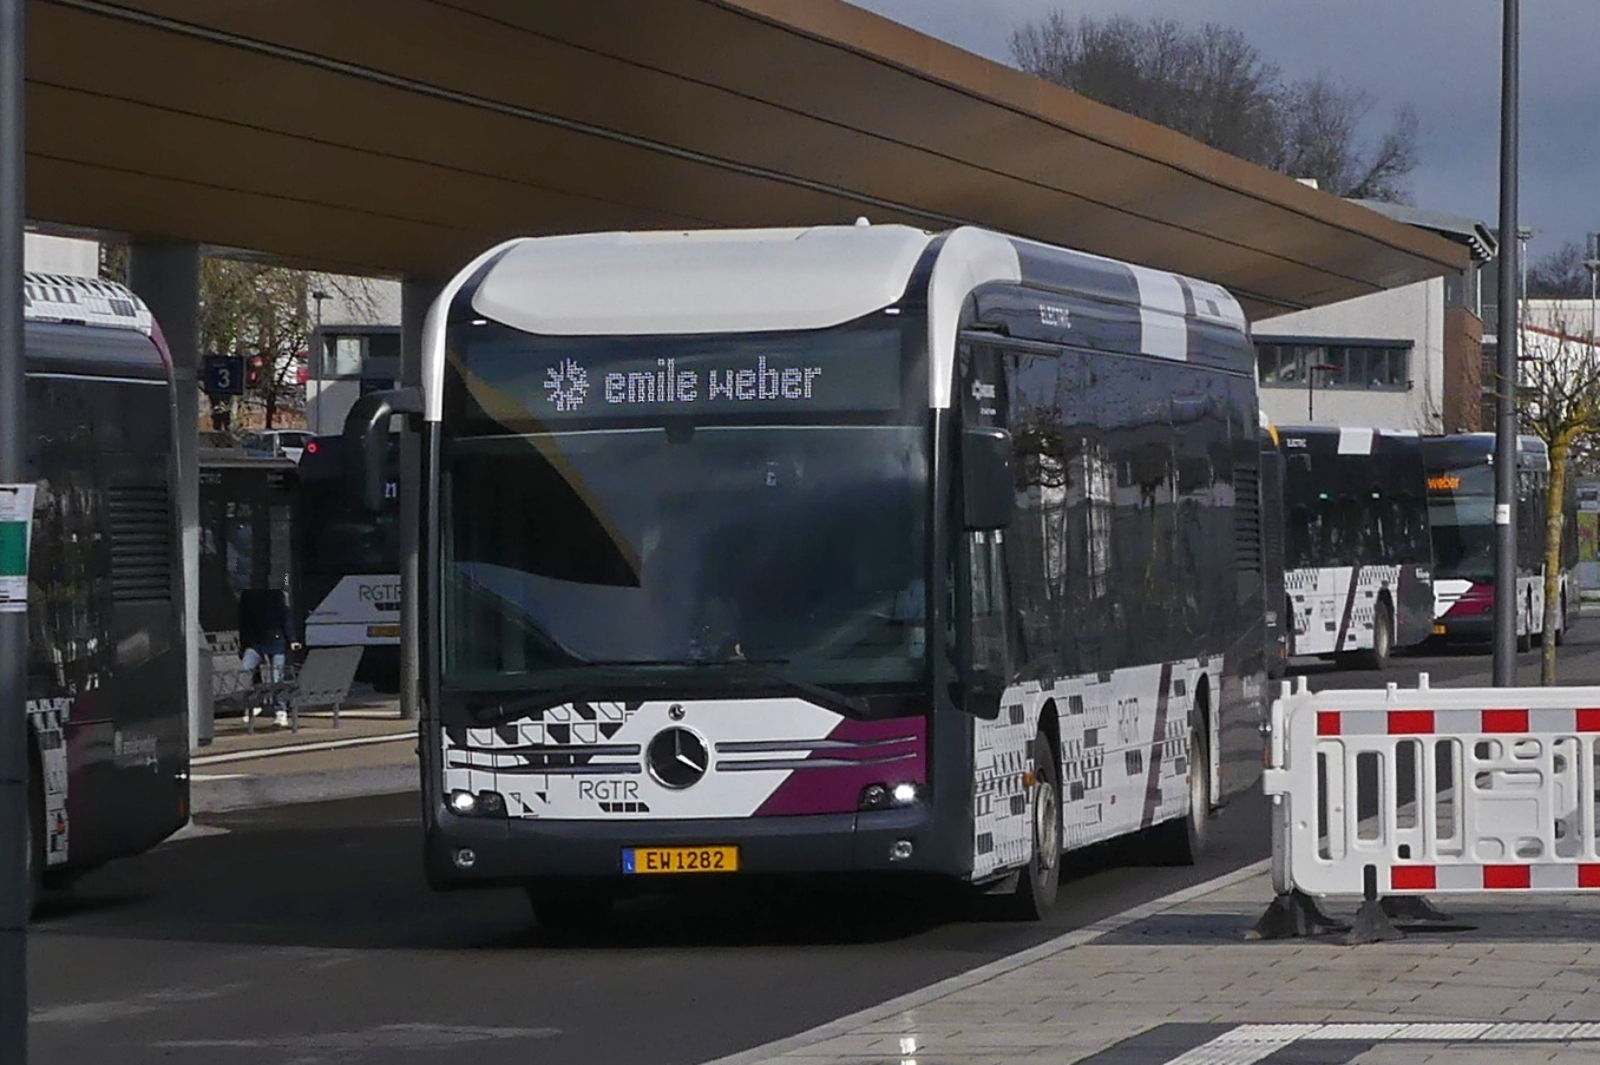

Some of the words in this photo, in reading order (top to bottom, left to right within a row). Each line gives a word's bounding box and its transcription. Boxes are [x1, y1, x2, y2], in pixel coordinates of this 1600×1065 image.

[217, 369, 231, 388] 3
[605, 358, 698, 403] emile
[709, 356, 822, 400] weber
[578, 780, 639, 800] RGTR
[646, 851, 724, 870] EW1282
